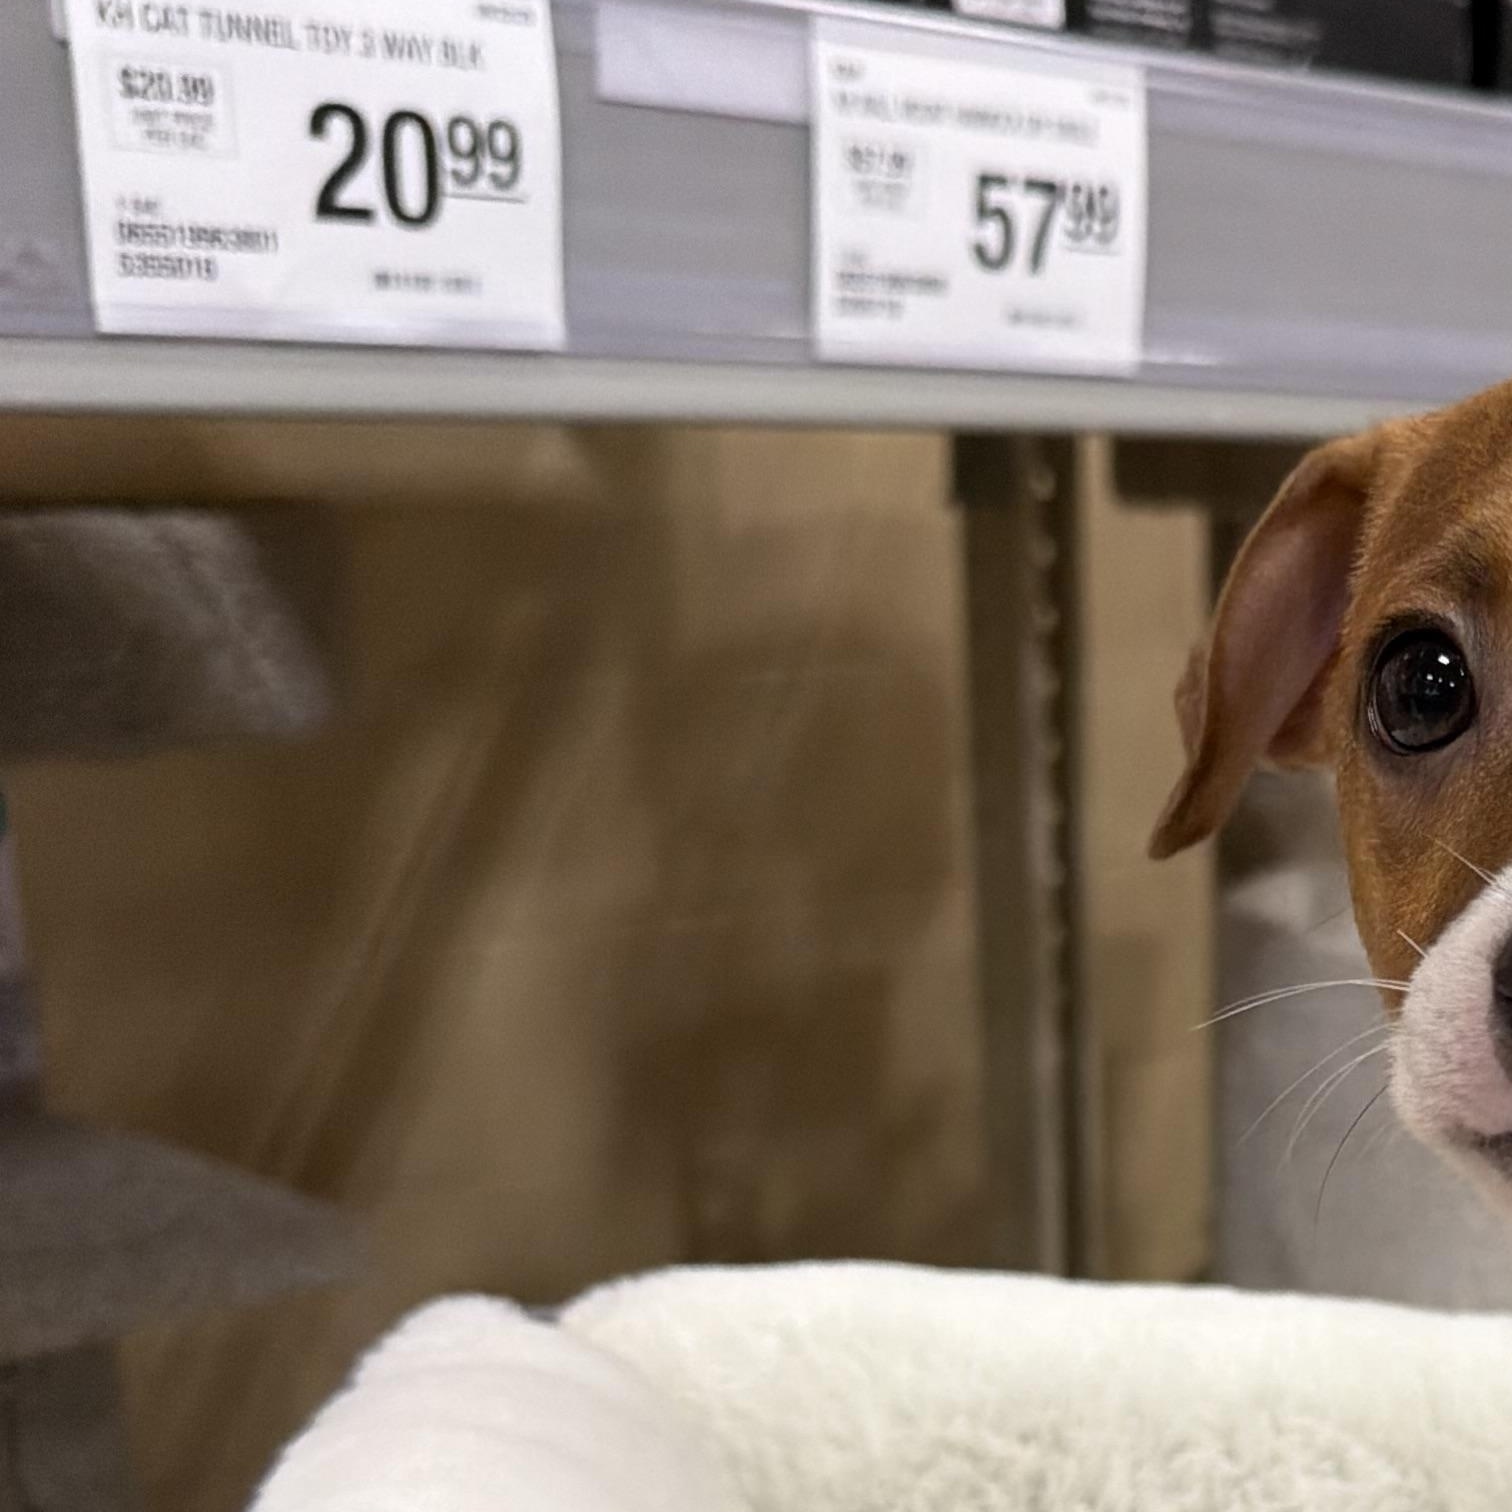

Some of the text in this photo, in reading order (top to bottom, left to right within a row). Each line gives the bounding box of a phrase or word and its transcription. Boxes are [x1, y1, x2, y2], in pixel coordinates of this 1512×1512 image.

[198, 9, 299, 51] TUNNEL
[304, 19, 351, 53] TOY
[383, 31, 433, 64] WAY
